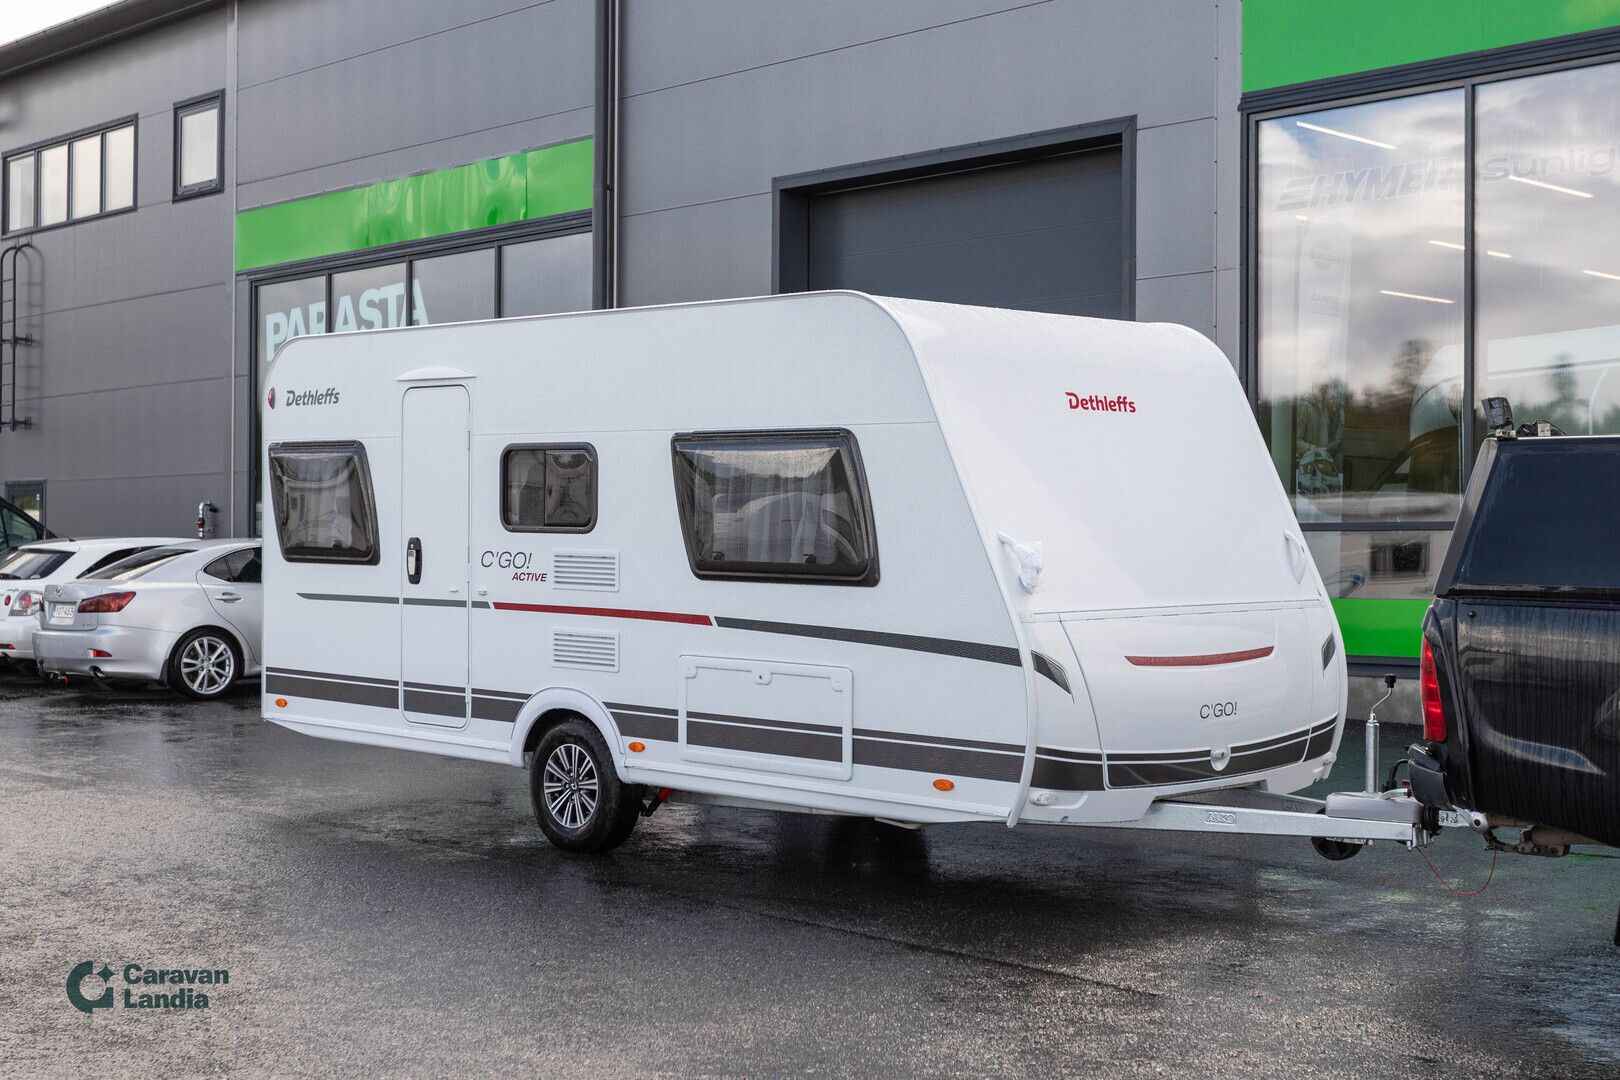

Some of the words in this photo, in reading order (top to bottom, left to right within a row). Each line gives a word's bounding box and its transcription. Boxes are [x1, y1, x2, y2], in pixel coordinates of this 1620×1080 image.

[286, 387, 340, 407] Dethleffs
[1065, 392, 1136, 413] Dethleffs
[481, 550, 532, 569] C'GO!
[511, 572, 547, 582] ACTIVE
[1200, 702, 1237, 719] C'GO!
